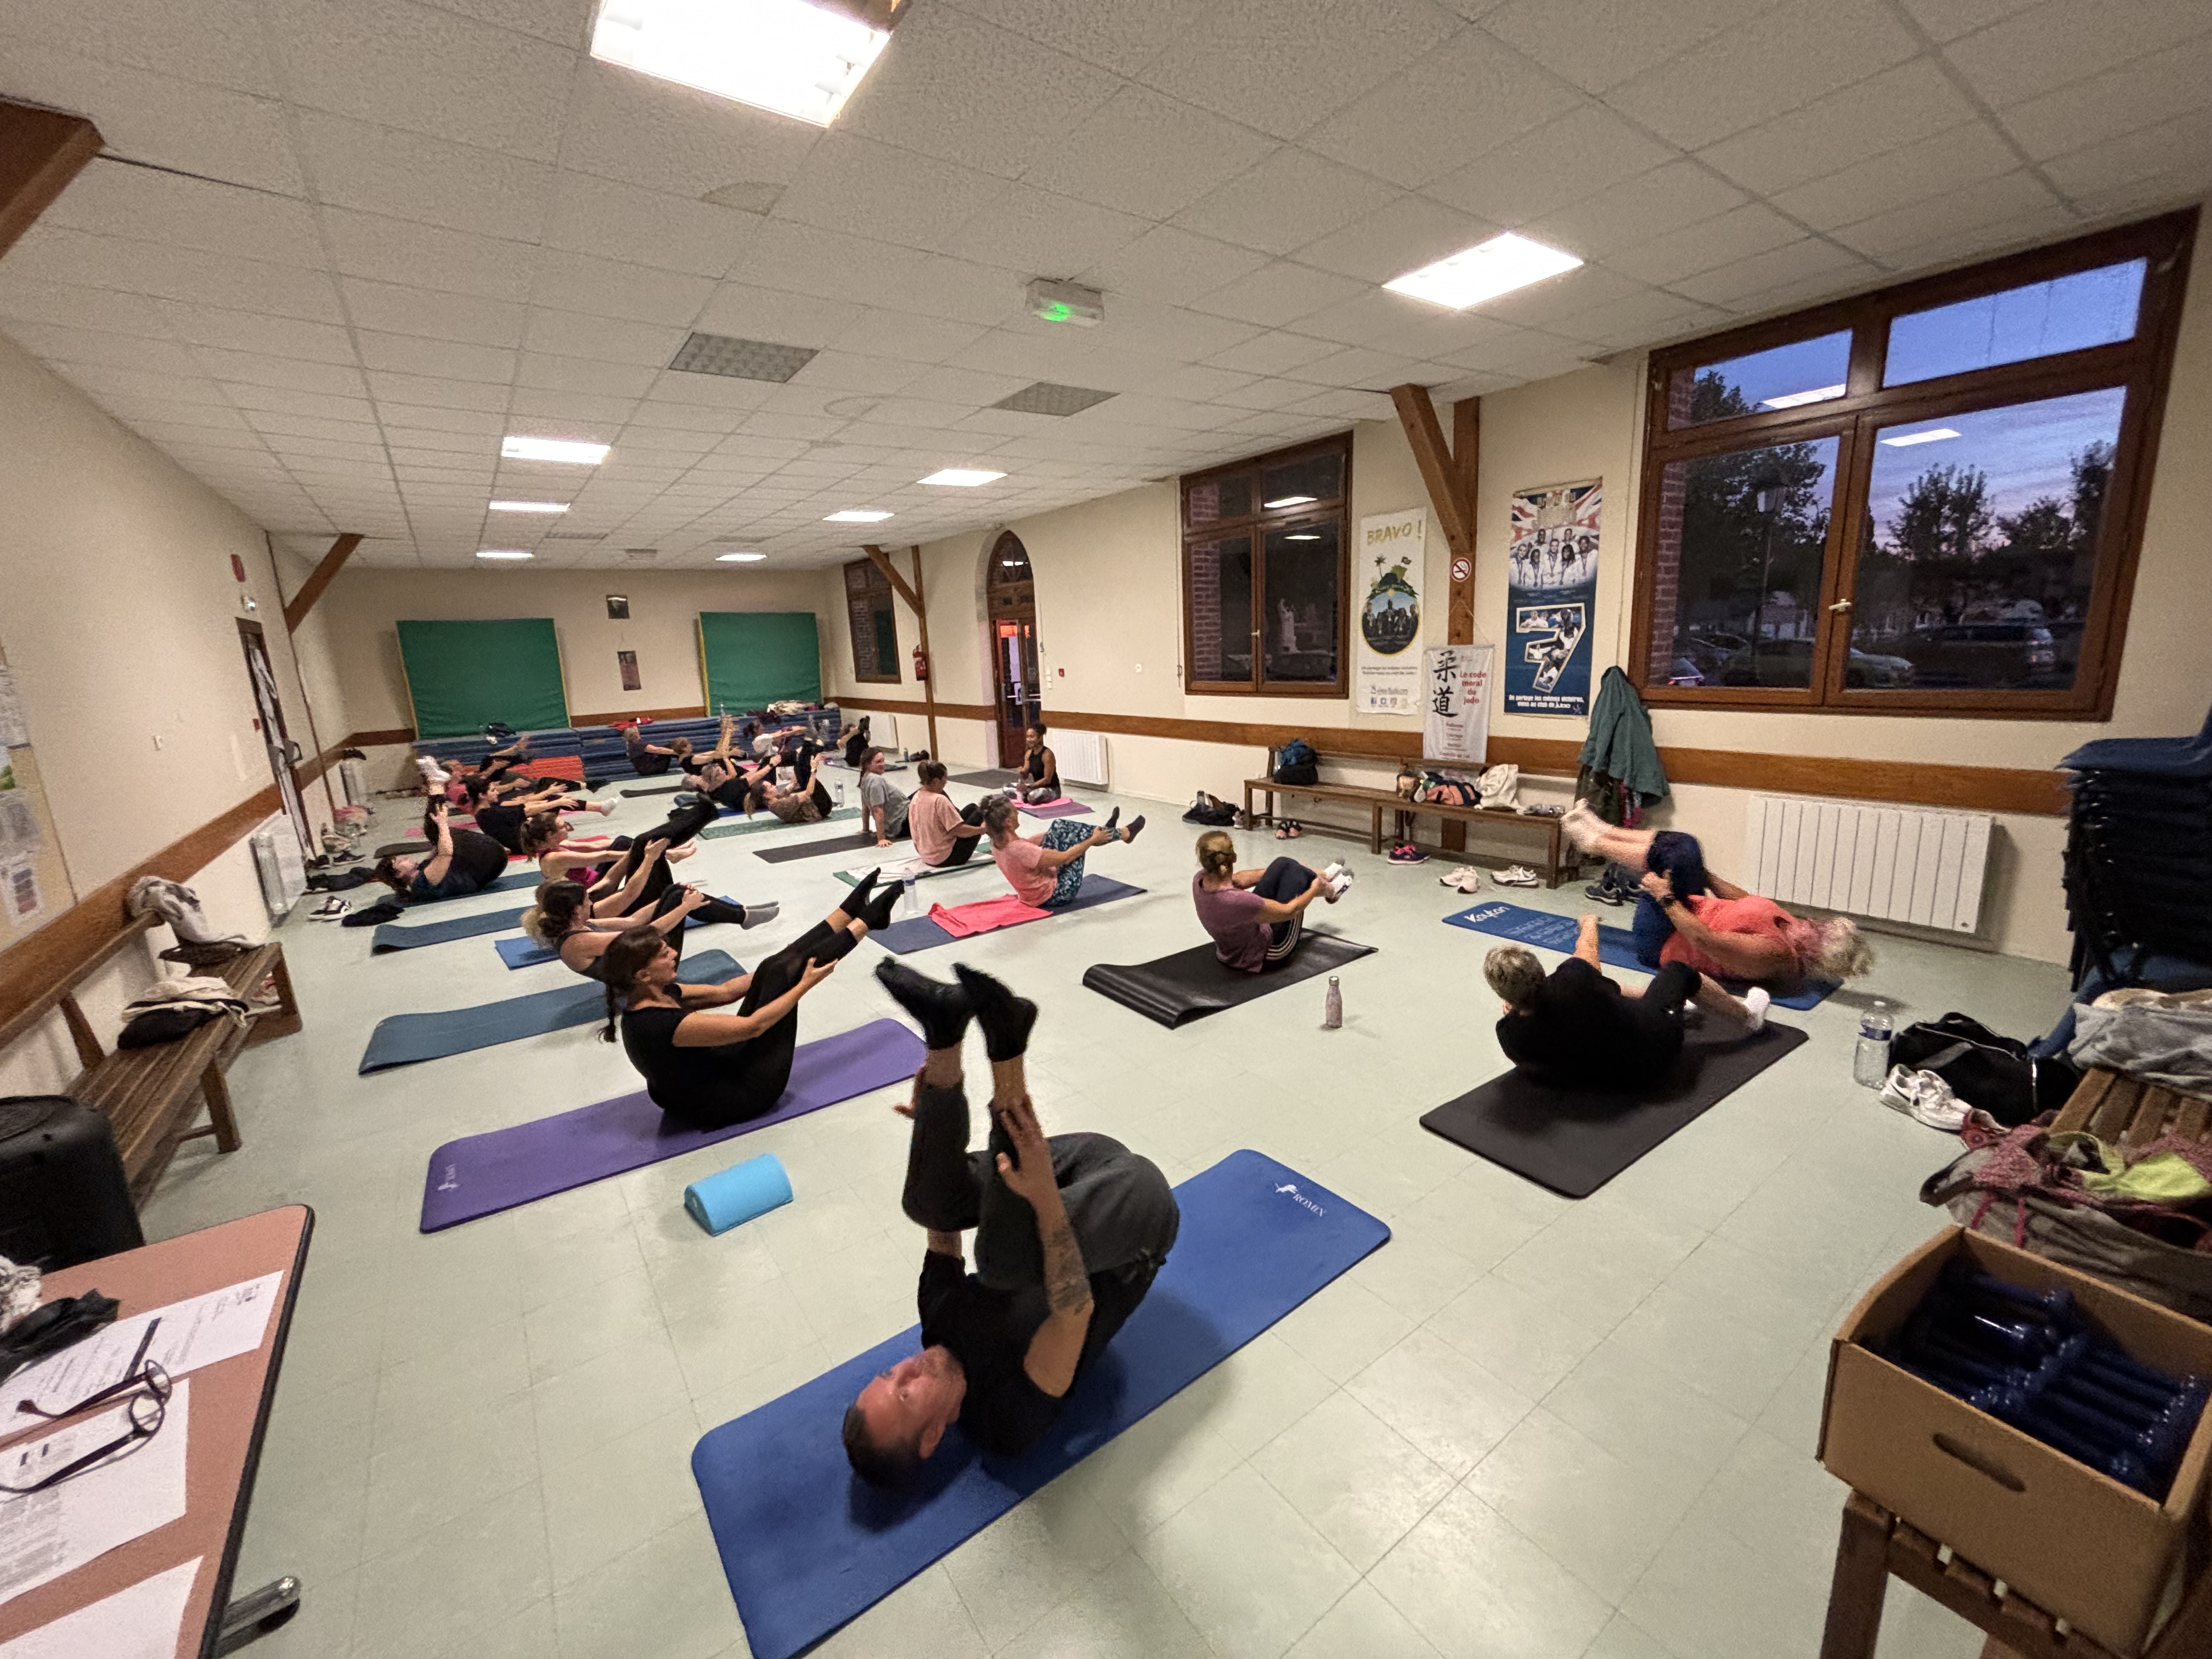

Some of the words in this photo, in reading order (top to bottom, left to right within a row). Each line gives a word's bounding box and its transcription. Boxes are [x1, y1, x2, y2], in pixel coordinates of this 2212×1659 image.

[1367, 522, 1412, 546] BRAVO
[1417, 520, 1422, 540] !
[1469, 670, 1487, 679] code
[1432, 650, 1459, 718] 柔道
[1463, 696, 1480, 706] judo
